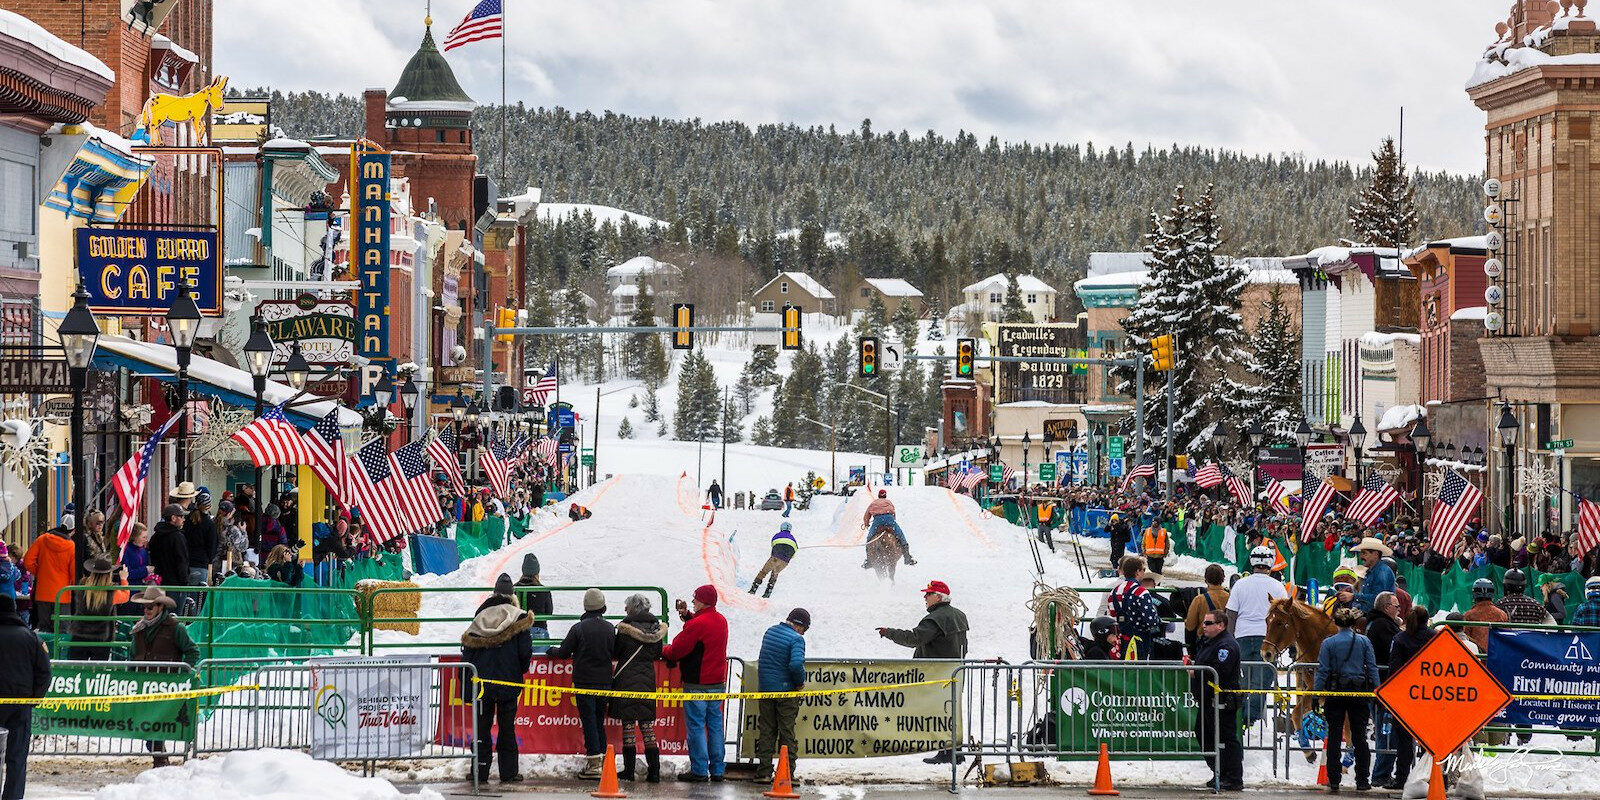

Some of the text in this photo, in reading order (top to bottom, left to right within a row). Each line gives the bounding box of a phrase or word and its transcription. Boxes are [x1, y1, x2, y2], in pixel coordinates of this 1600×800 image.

[89, 235, 210, 260] GOLDEN BURRO
[362, 161, 384, 353] MANHATTAN
[101, 263, 200, 301] CAFE
[267, 316, 356, 341] ELAWARE
[1001, 327, 1056, 342] Leadville's
[1011, 343, 1067, 358] Legendary
[1019, 361, 1068, 372] Saloon
[1032, 374, 1064, 388] 1879
[1047, 420, 1073, 434] ANTIQU
[852, 667, 926, 684] Mercantile
[1420, 661, 1469, 678] ROAD
[1520, 658, 1584, 676] Community
[86, 673, 139, 697] village
[142, 677, 193, 696] resort
[1512, 675, 1542, 693] First
[358, 695, 420, 704] BEHIND EVERY
[838, 694, 849, 707] &
[853, 691, 905, 709] AMMO
[1090, 690, 1181, 712] Community
[1409, 685, 1478, 702] CLOSED
[95, 702, 111, 713] us
[359, 704, 390, 712] PROJECT
[1552, 700, 1561, 708] in
[1562, 700, 1596, 711] Historic
[813, 714, 880, 732] CAMPING
[1091, 708, 1166, 722] of Colorado
[1528, 710, 1555, 721] Come
[1556, 713, 1587, 724] grow
[1091, 728, 1128, 738] Where
[1130, 729, 1176, 738] common
[662, 739, 682, 753] Dogs
[804, 738, 856, 755] LIQUOR
